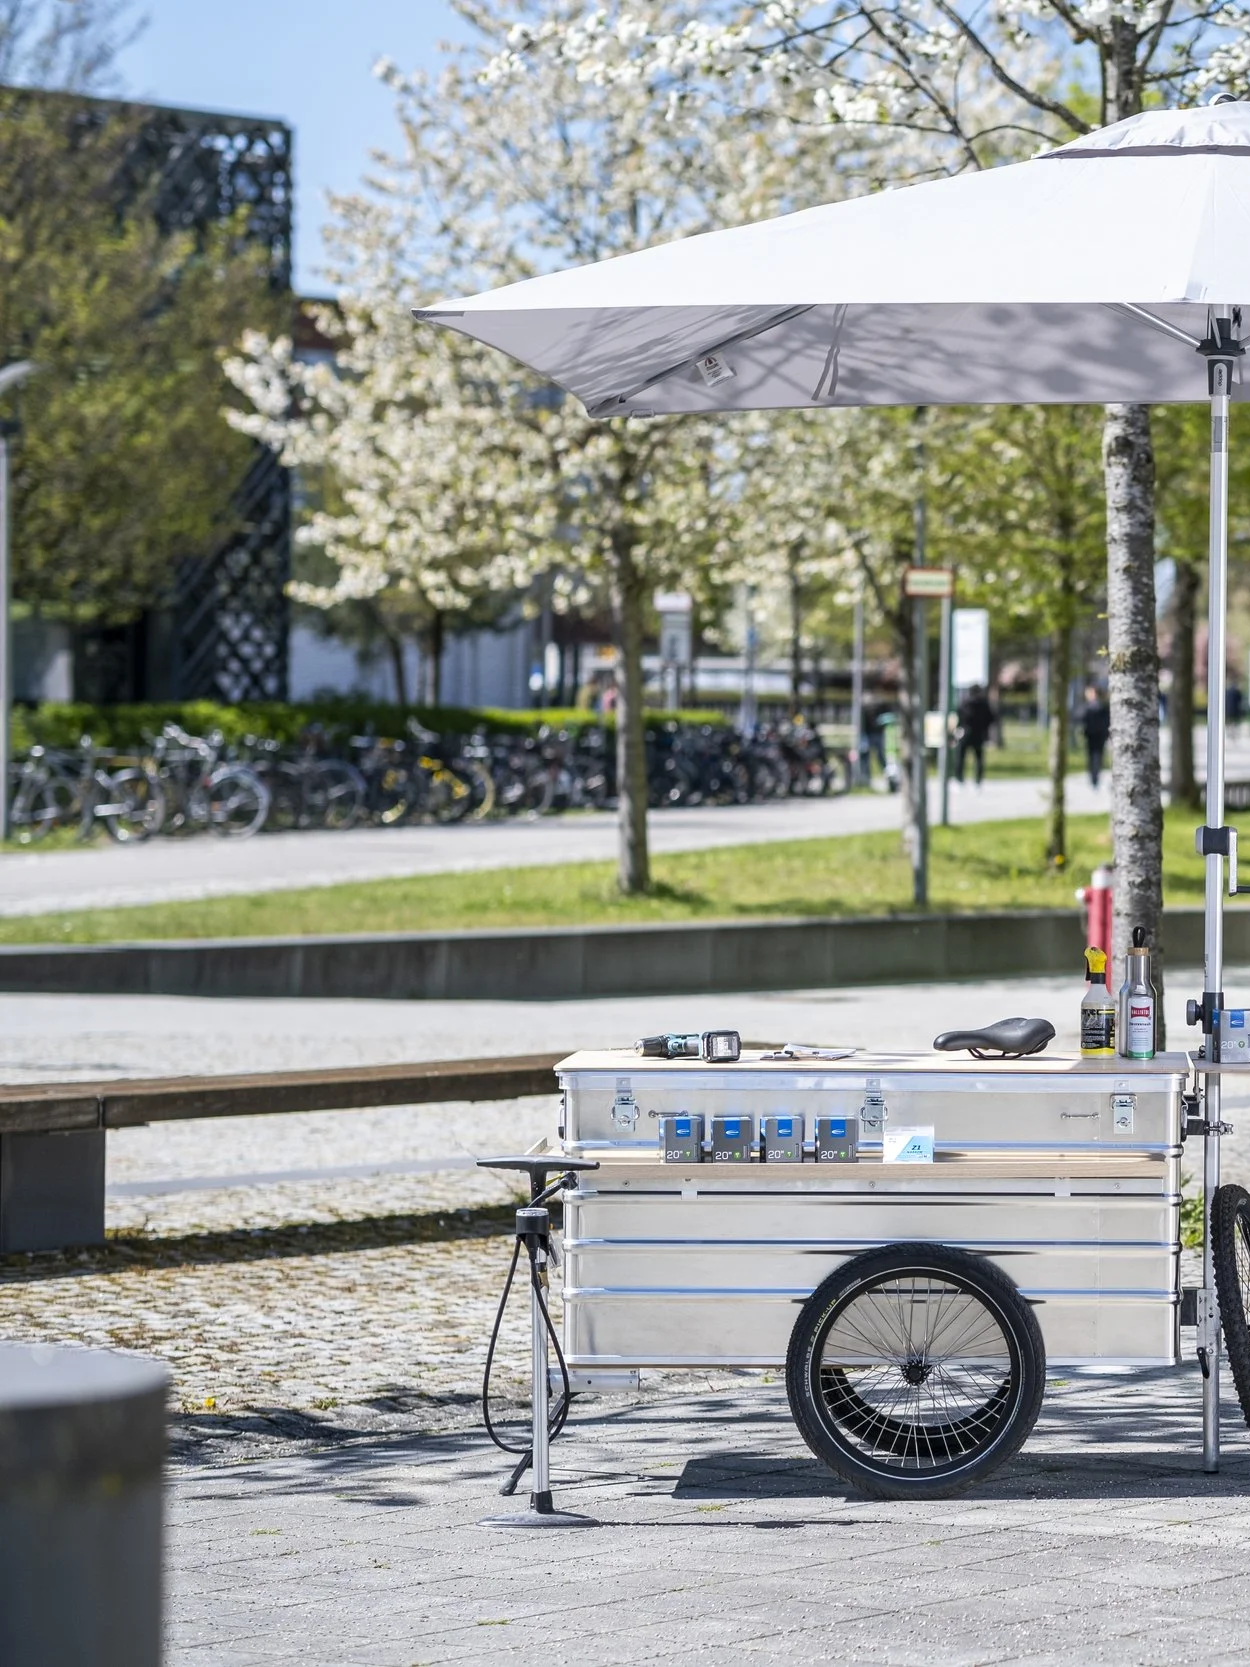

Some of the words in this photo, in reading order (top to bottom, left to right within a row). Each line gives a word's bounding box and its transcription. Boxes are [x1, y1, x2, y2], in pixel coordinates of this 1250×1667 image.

[666, 1150, 683, 1159] 20"
[715, 1151, 732, 1160] 20"
[768, 1150, 784, 1159] 20"
[820, 1150, 838, 1159] 20"
[804, 1346, 812, 1398] SCHWALBE
[814, 1298, 837, 1334] PICK-UP
